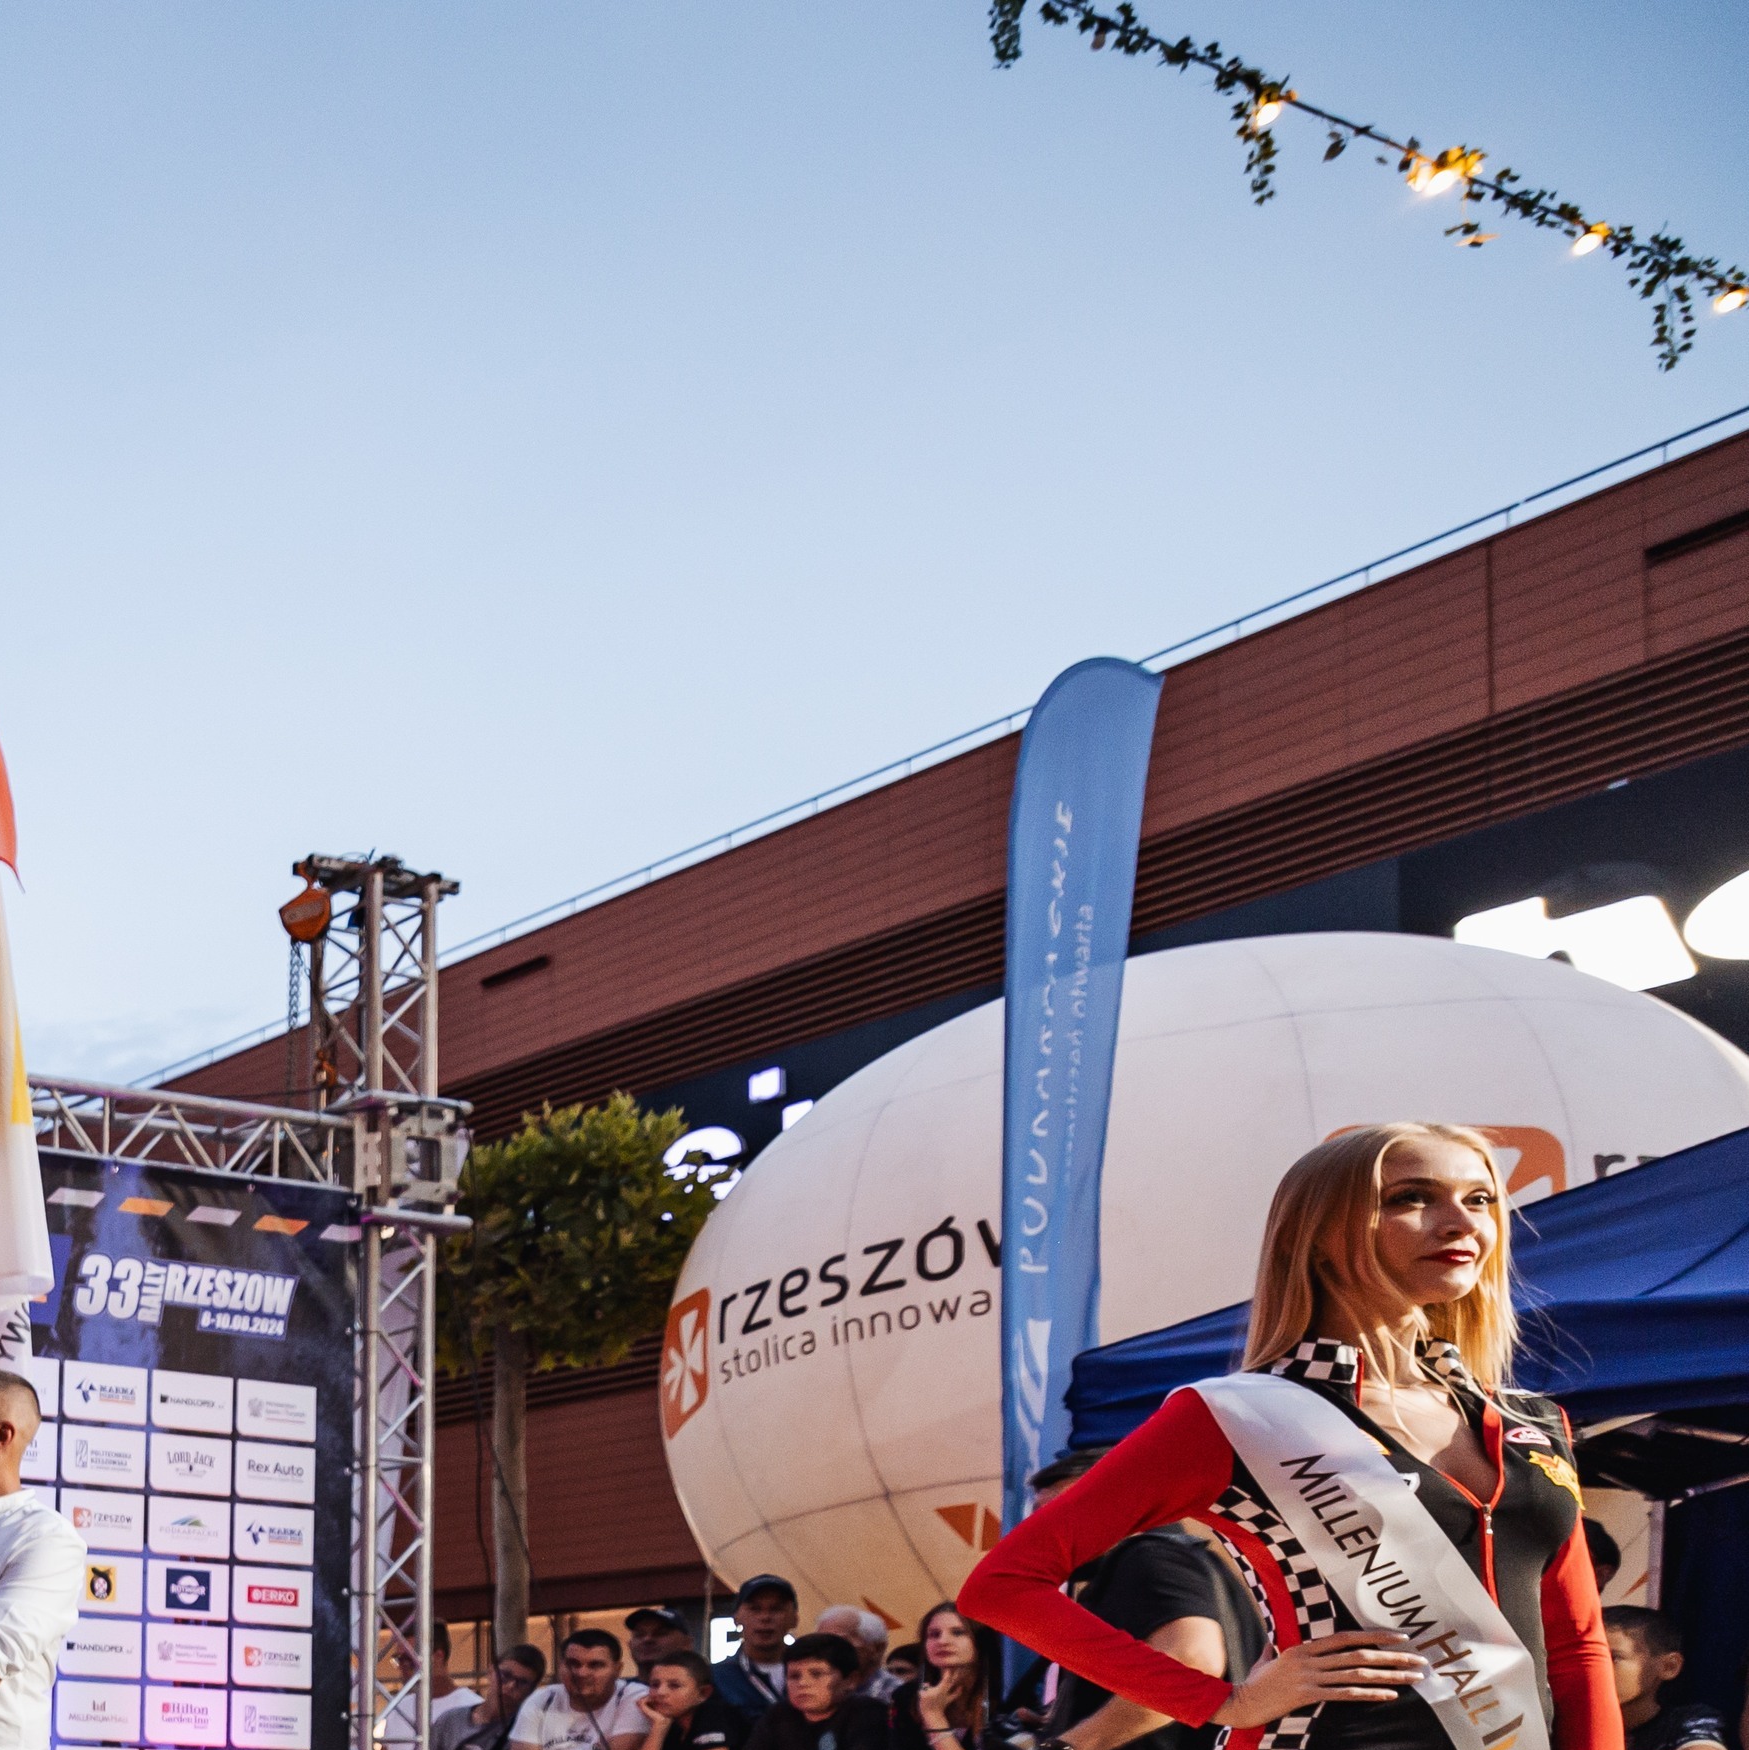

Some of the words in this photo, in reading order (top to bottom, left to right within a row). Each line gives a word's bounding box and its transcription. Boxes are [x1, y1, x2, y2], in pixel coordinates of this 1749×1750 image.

[76, 1254, 144, 1320] 33
[163, 1263, 295, 1316] RZESZOW
[718, 1329, 817, 1385] stolica
[832, 1290, 994, 1347] innowa
[166, 1450, 192, 1465] LORD
[193, 1450, 216, 1468] JACK
[247, 1458, 270, 1473] Rex
[273, 1463, 305, 1478] Auto
[171, 1702, 209, 1716] Hilton
[161, 1714, 193, 1724] Garden
